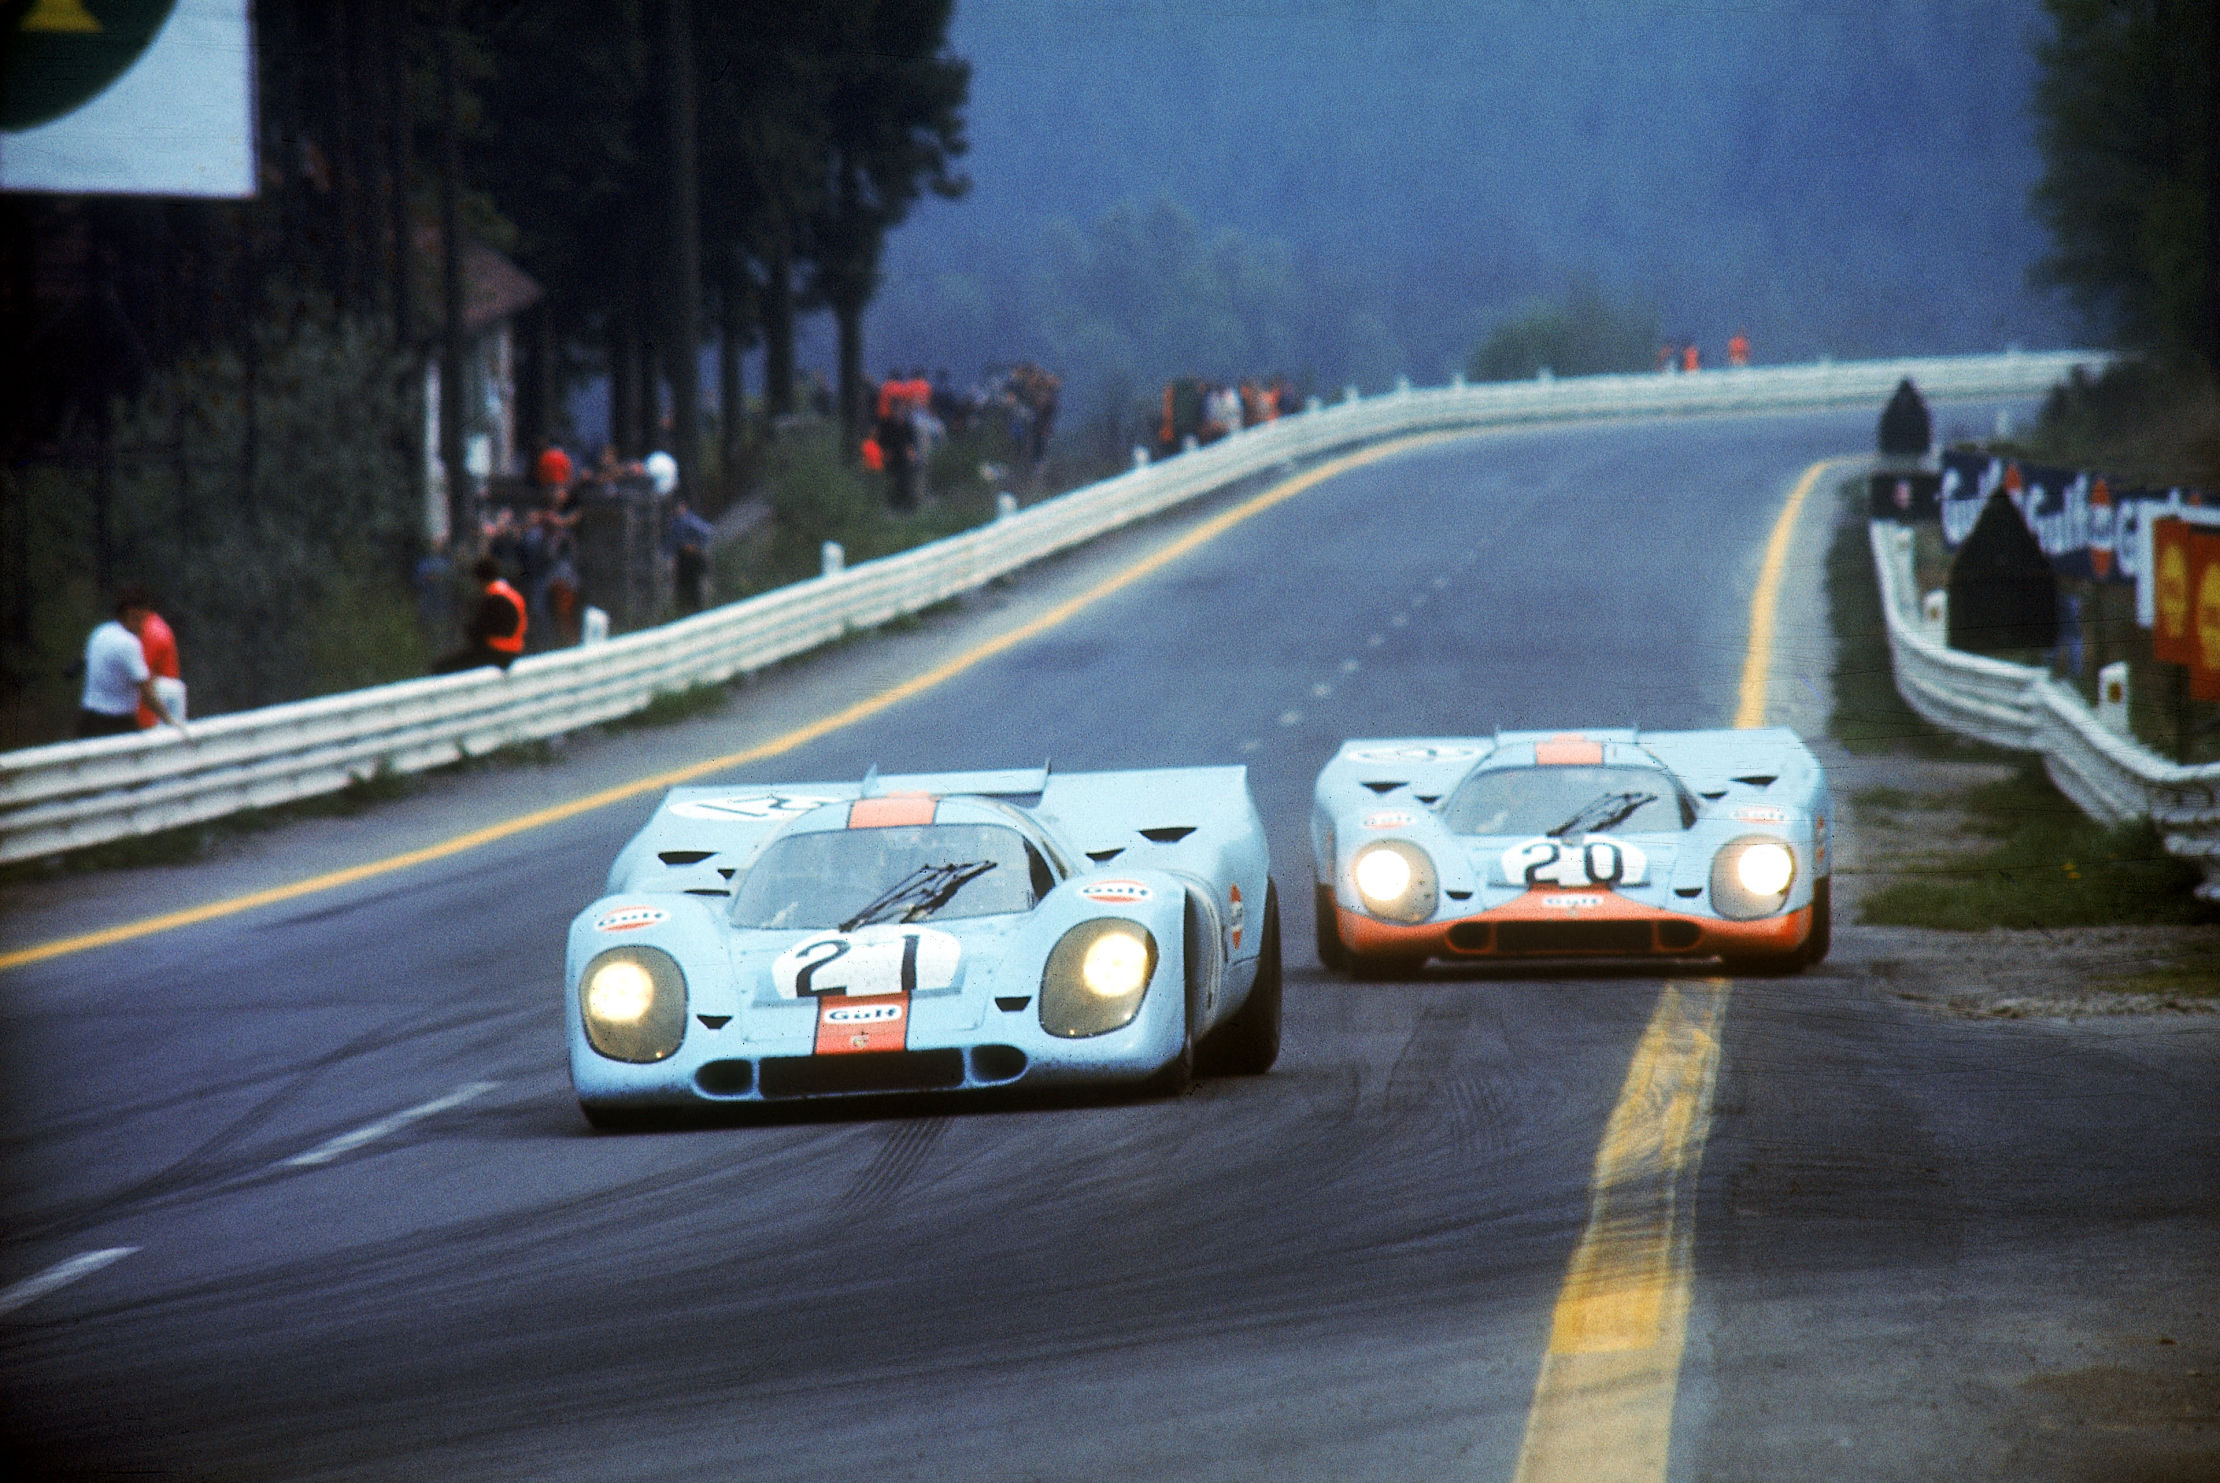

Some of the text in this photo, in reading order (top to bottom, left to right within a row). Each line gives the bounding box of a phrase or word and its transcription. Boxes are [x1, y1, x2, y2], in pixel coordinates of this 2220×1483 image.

[1522, 842, 1624, 886] 20
[795, 933, 921, 998] 21
[828, 1006, 898, 1021] Gulf
